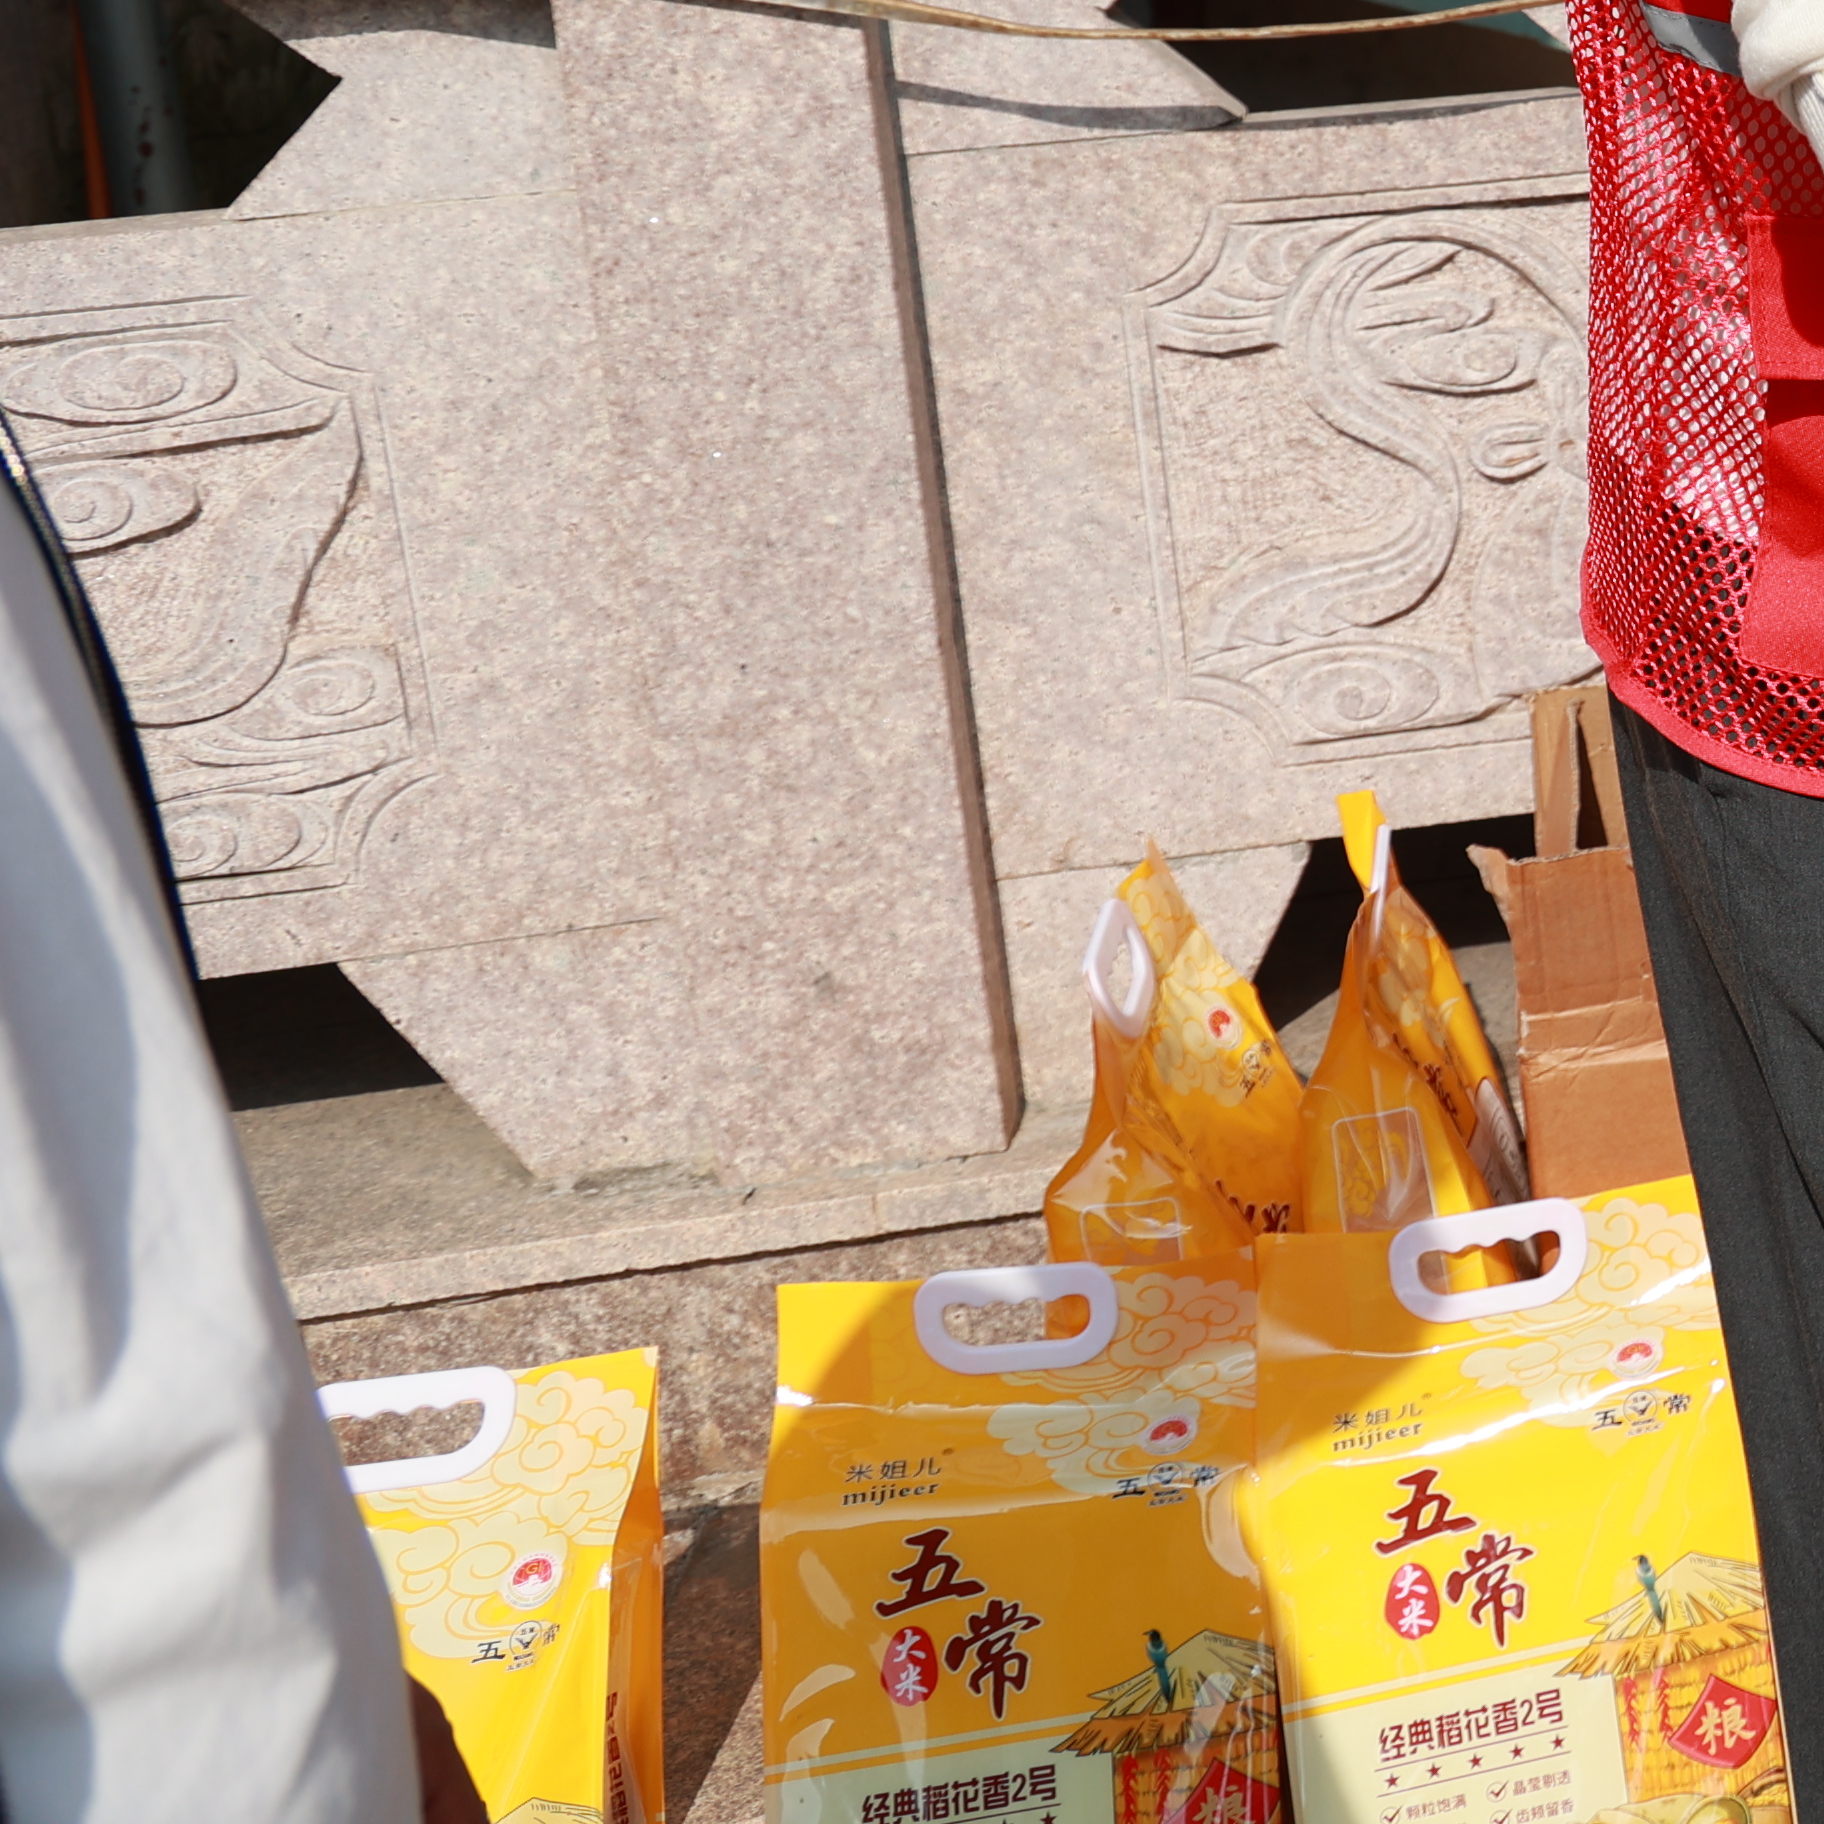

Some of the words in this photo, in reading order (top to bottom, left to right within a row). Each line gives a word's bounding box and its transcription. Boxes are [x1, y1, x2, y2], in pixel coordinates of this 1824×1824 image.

[1332, 1422, 1424, 1453] mijieer
[841, 1481, 940, 1507] mijieer
[844, 1458, 942, 1484] 米姐儿
[1394, 1563, 1435, 1639] 大米
[892, 1627, 930, 1702] 大米
[1378, 1687, 1565, 1763] 经典稻花香2号
[1693, 1698, 1759, 1756] 粮
[861, 1763, 1058, 1824] 经典稻花香2号
